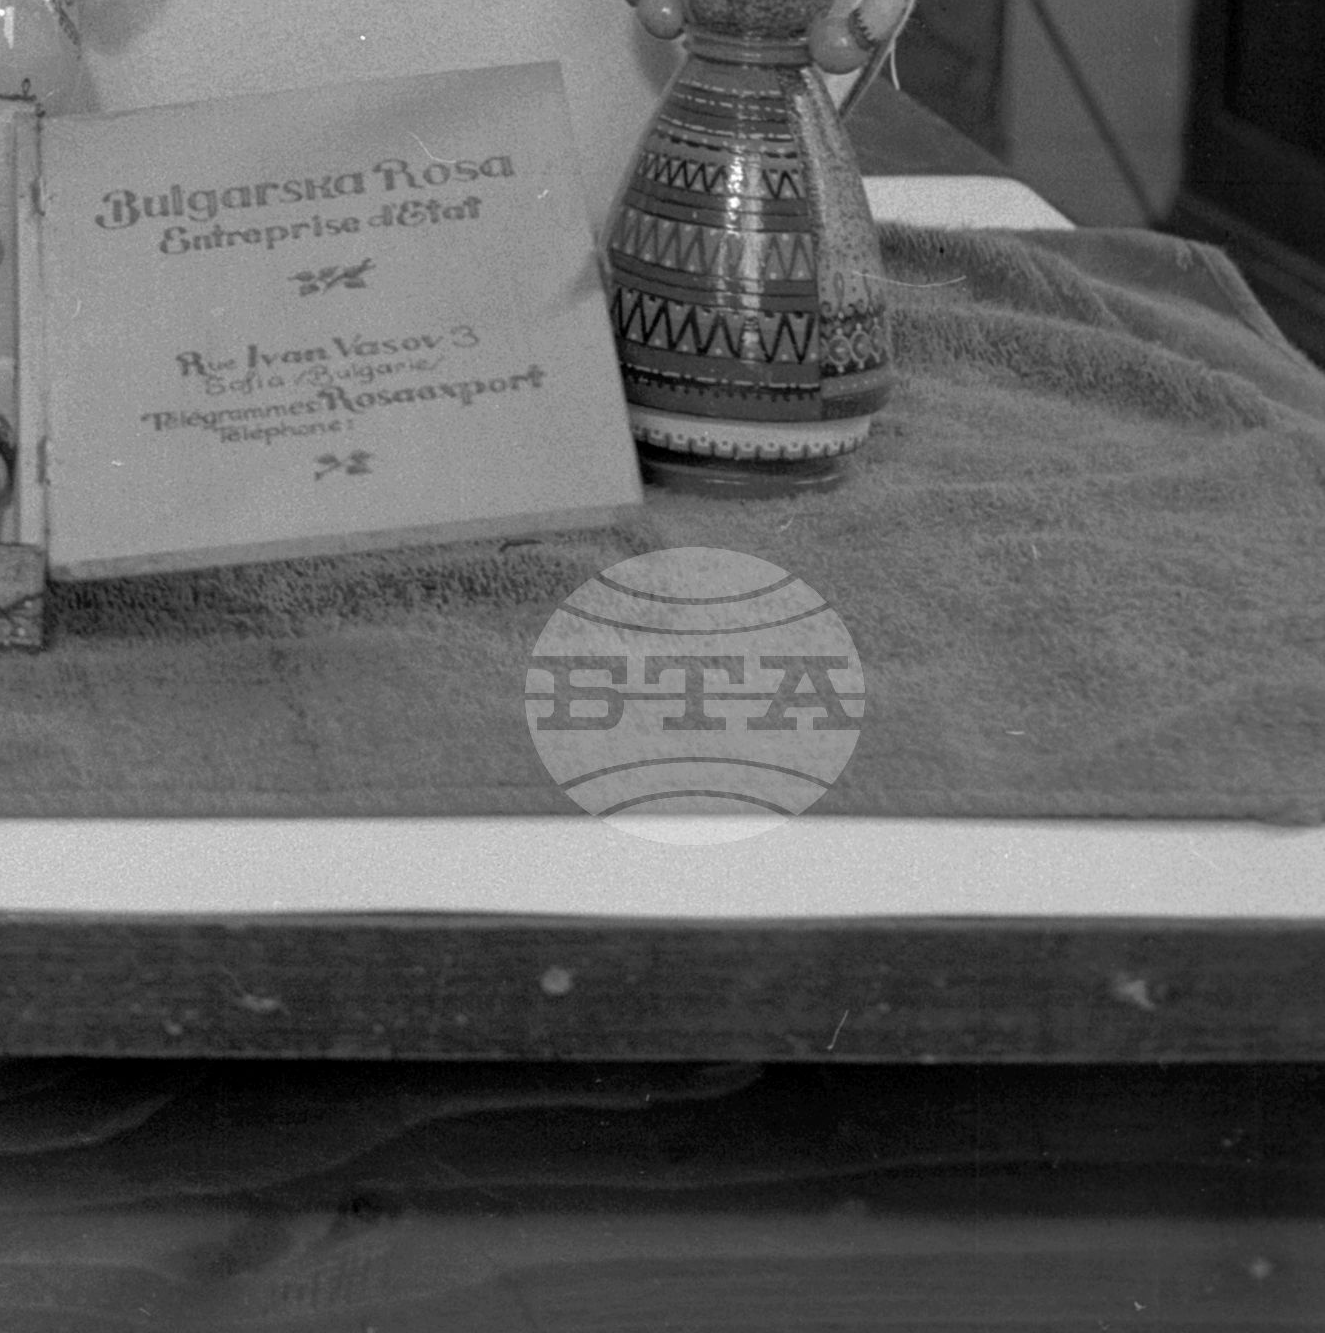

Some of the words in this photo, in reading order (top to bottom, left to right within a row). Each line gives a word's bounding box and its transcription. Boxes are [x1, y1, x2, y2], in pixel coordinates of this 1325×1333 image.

[95, 171, 366, 230] Bulgarska
[372, 153, 516, 194] Rosa
[158, 214, 361, 256] Entreprise
[175, 349, 237, 379] Rue
[246, 342, 329, 369] Ivan
[450, 324, 482, 349] 3
